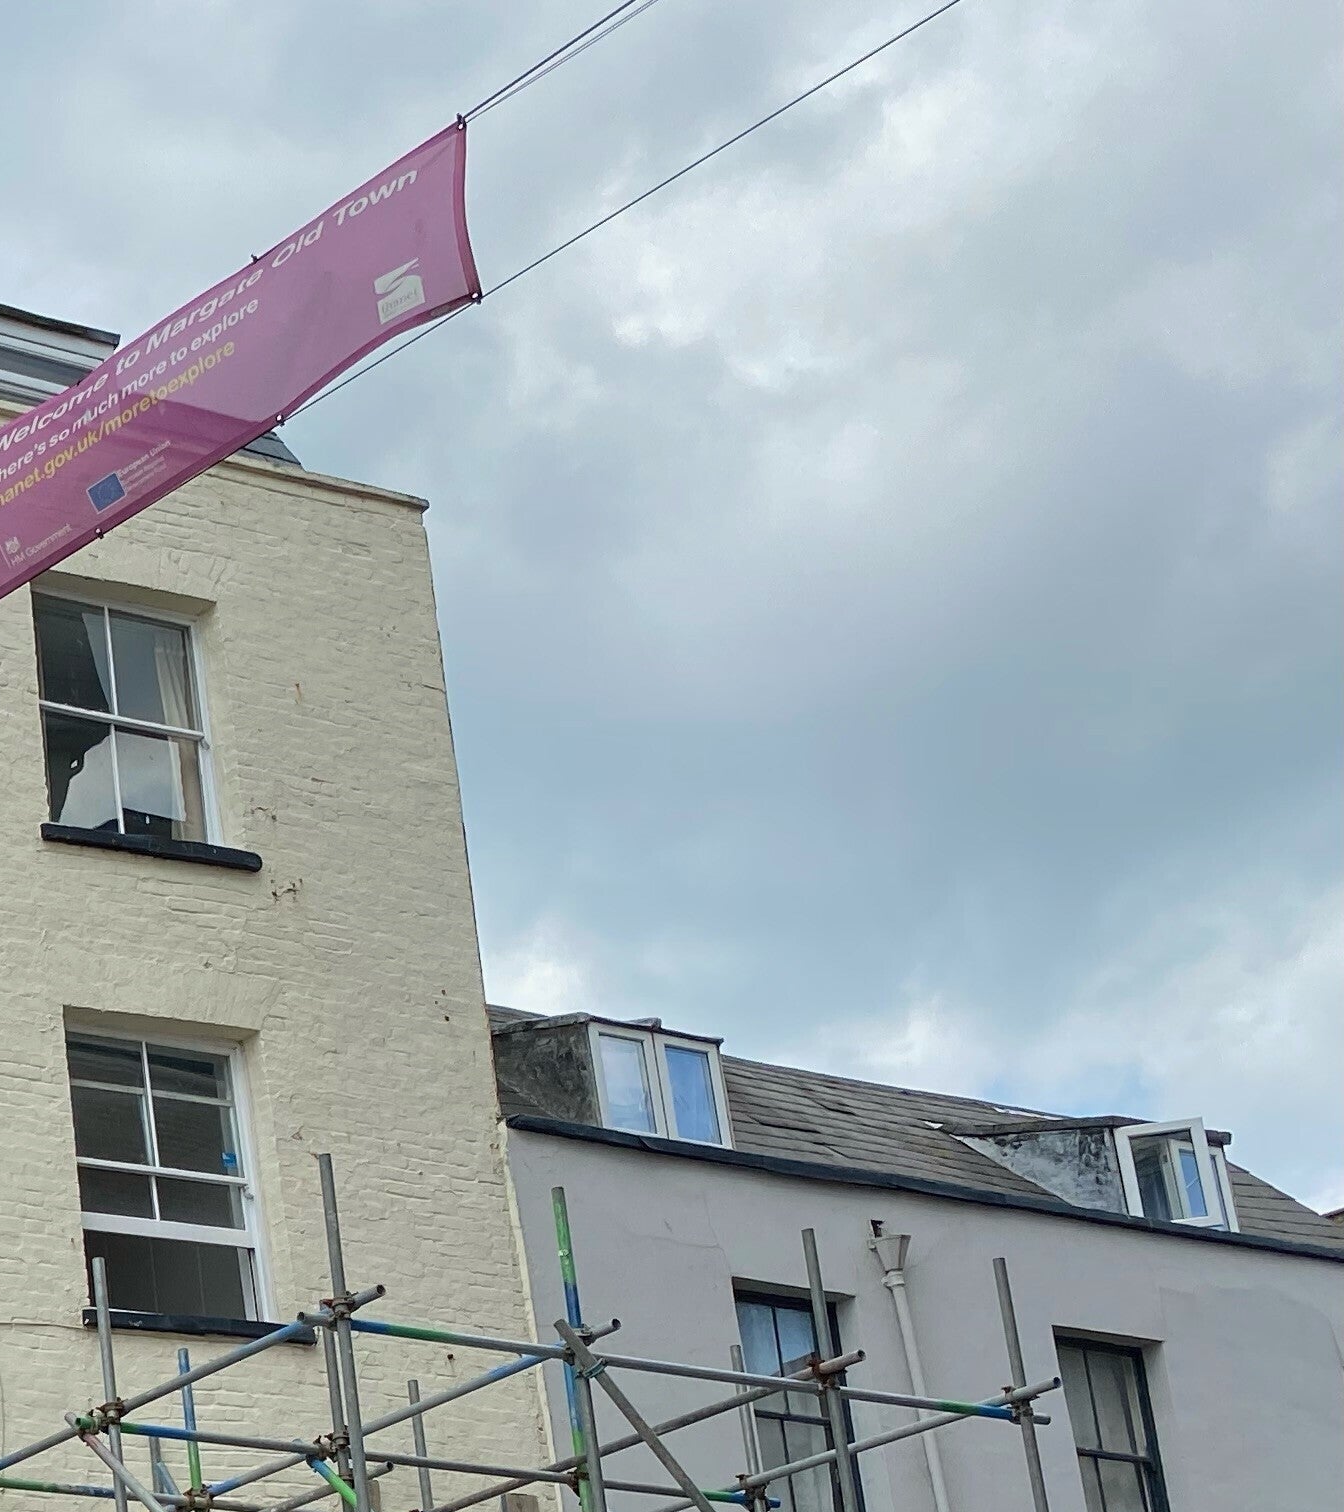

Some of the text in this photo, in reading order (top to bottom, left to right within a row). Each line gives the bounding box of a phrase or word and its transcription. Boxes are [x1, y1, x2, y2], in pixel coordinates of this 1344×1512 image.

[115, 350, 140, 376] to
[146, 269, 263, 354] Margate
[271, 221, 324, 268] Old
[333, 170, 418, 226] Town
[49, 430, 69, 448] so
[72, 392, 118, 434] much
[121, 359, 167, 398] more
[169, 347, 188, 367] to
[190, 299, 259, 350] explore
